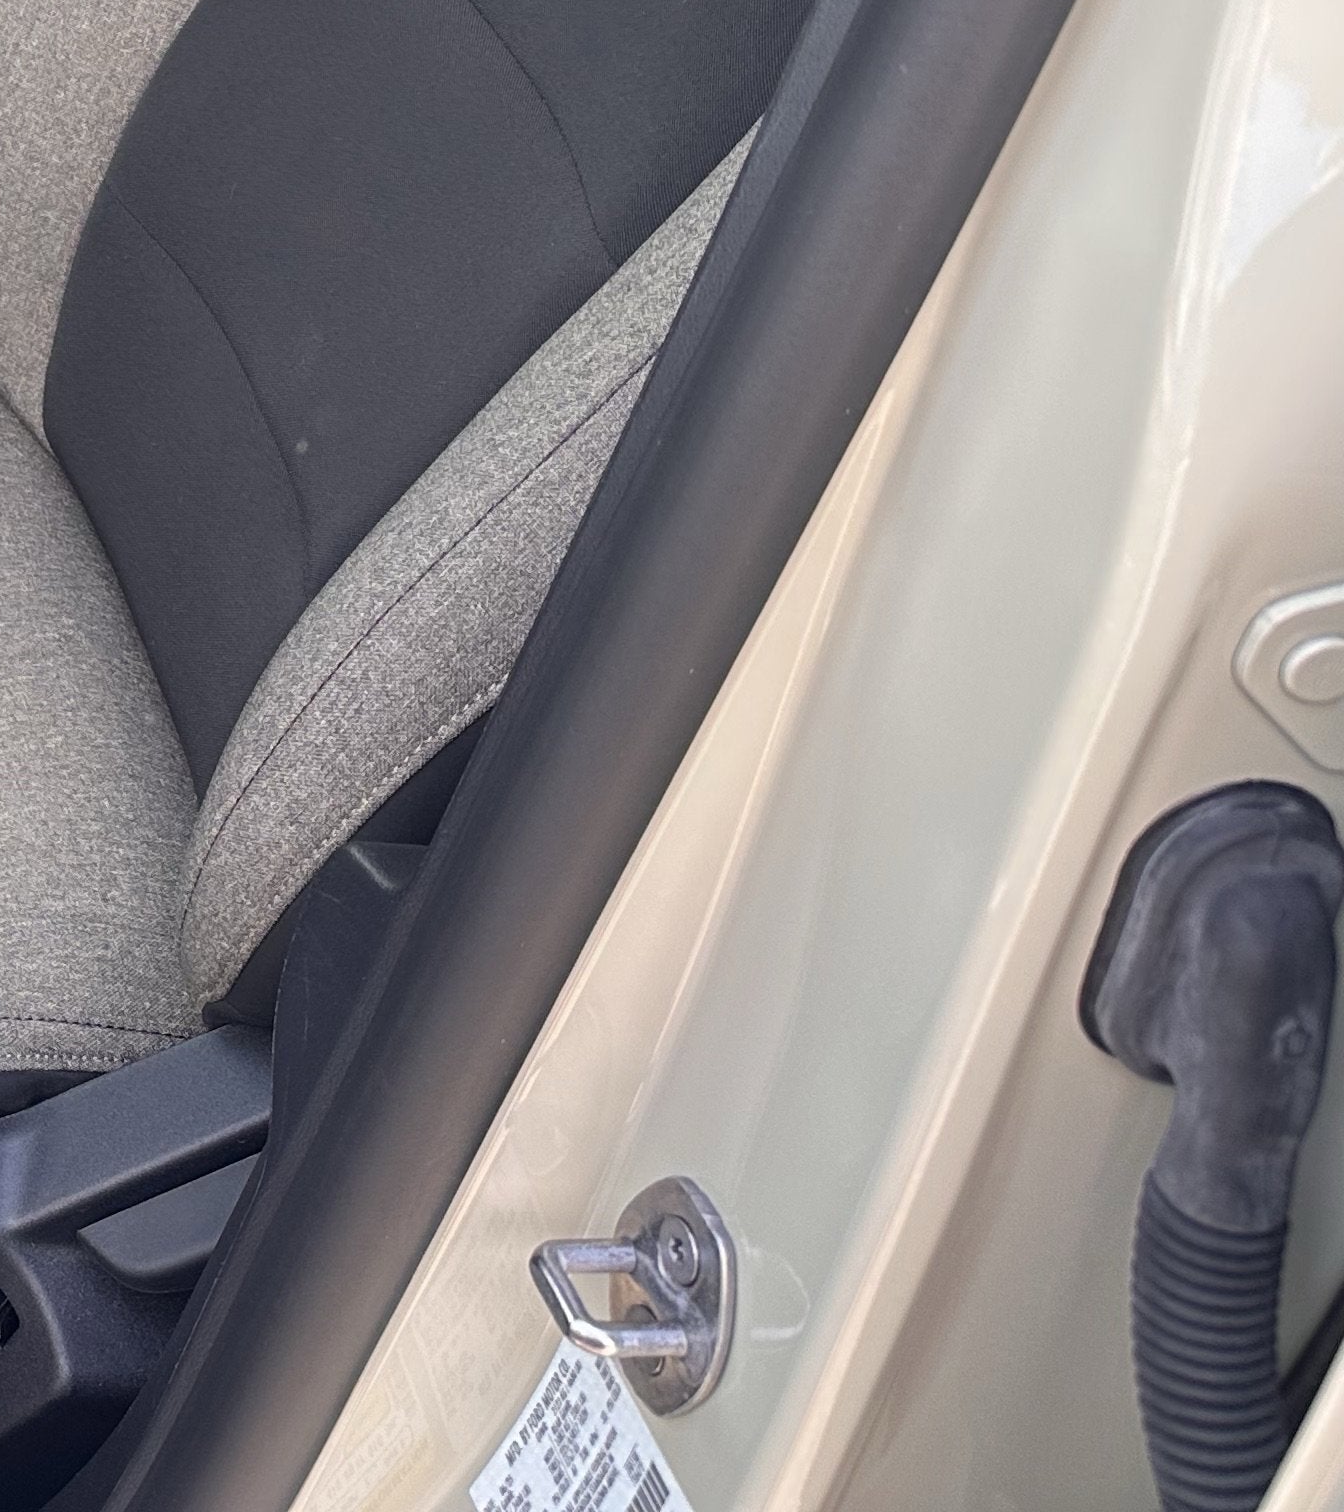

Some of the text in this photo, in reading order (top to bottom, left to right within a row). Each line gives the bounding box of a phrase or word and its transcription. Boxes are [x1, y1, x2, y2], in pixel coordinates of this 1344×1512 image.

[519, 1425, 531, 1445] BY
[527, 1402, 545, 1433] FORD
[541, 1371, 562, 1410] MOTOR
